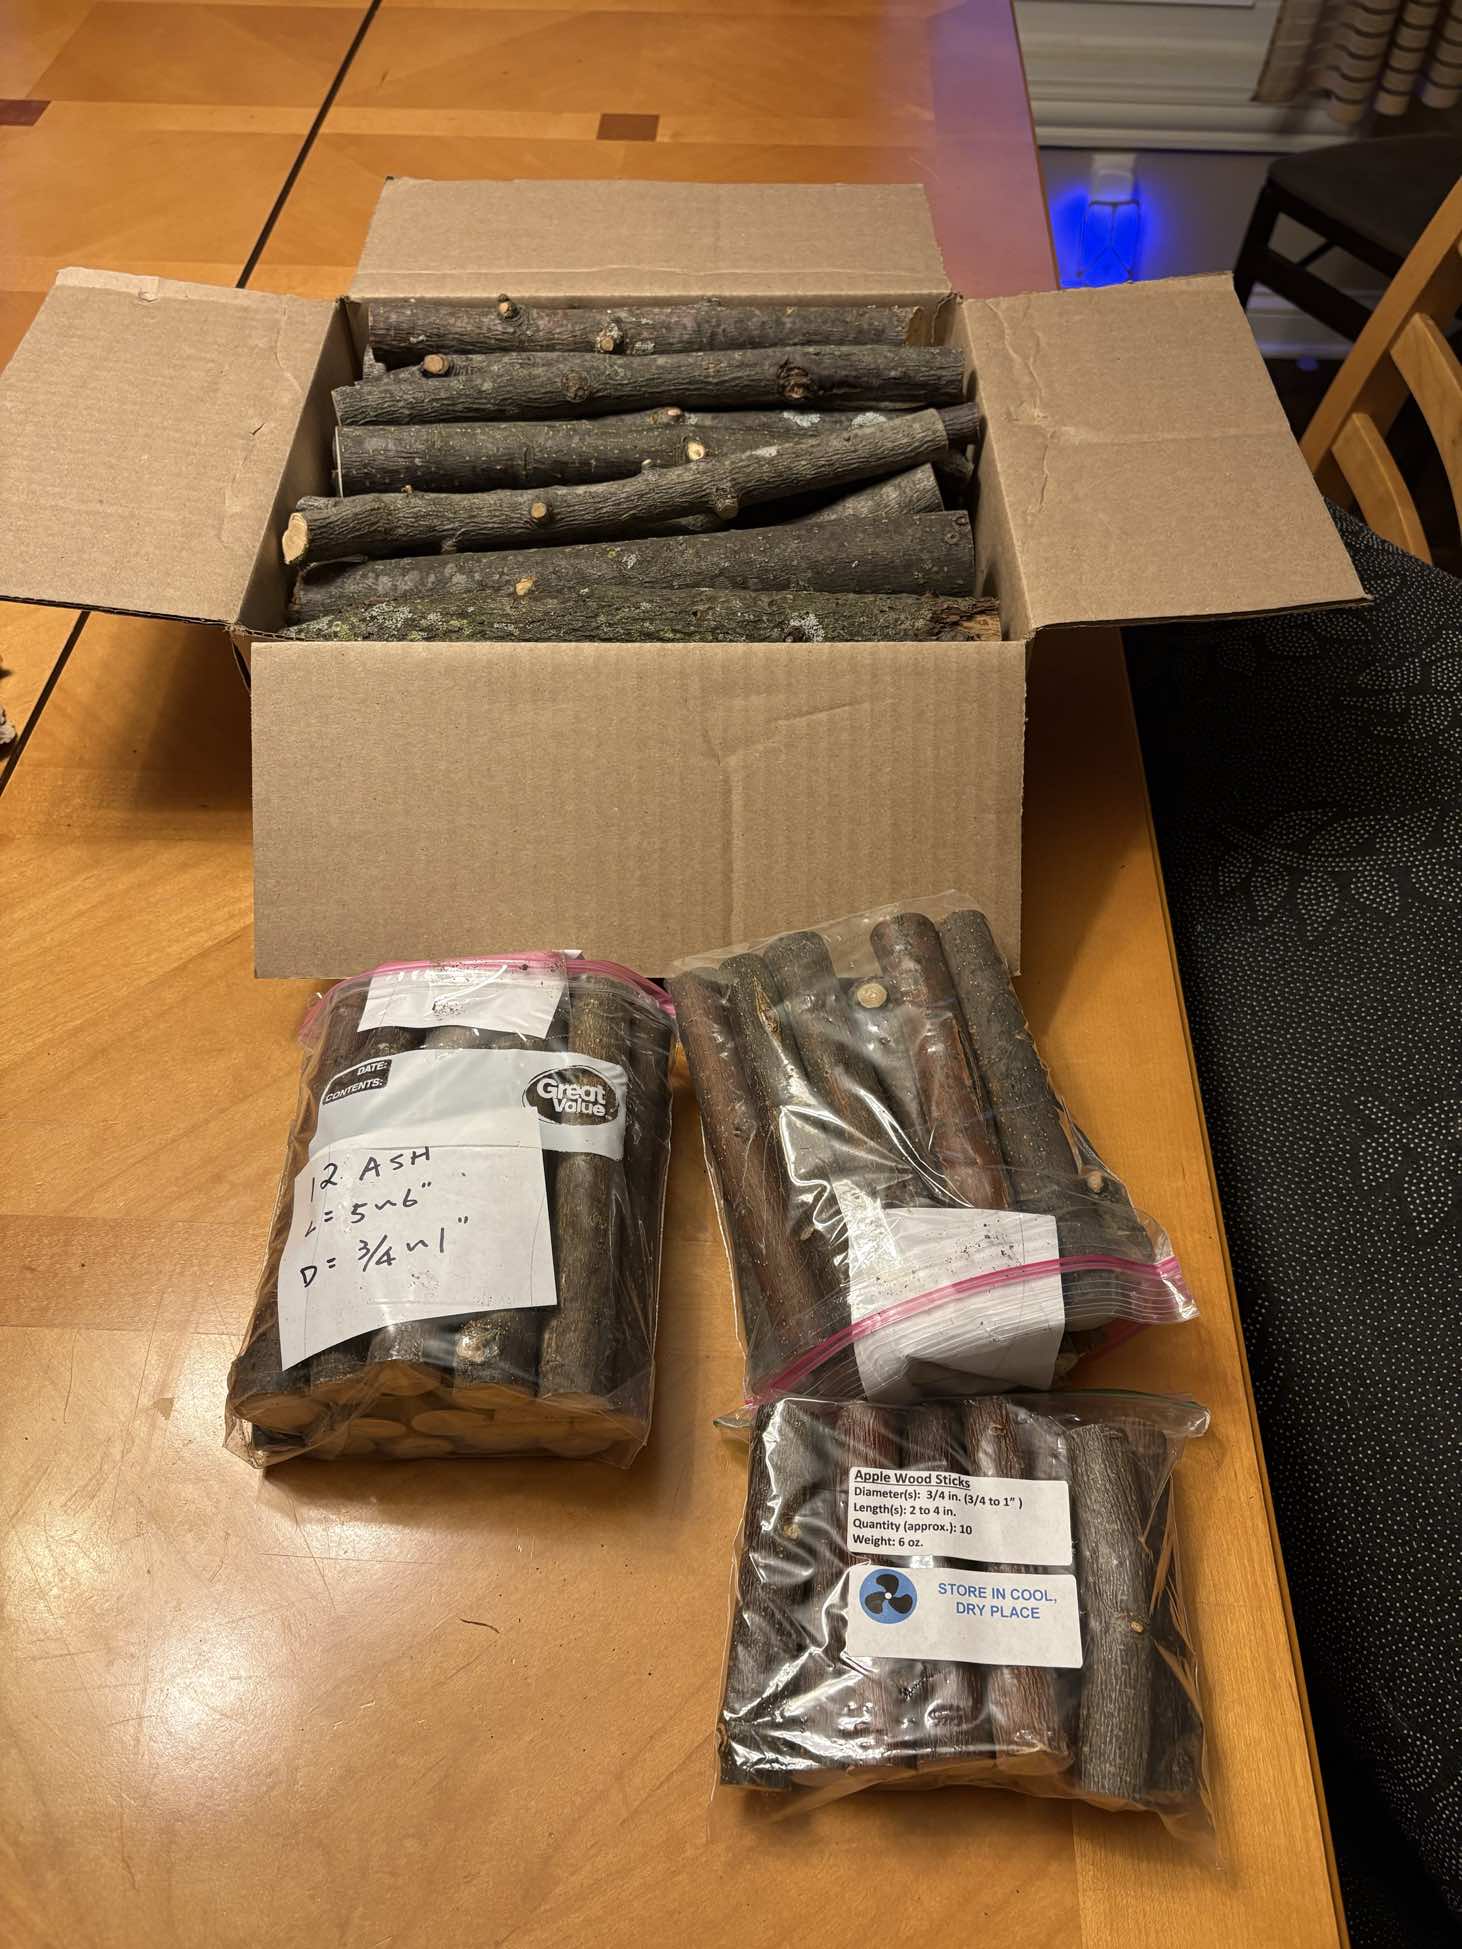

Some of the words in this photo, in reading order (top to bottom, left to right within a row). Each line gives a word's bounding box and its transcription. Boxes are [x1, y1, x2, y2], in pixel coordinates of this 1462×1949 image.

[357, 1061, 388, 1075] DATE:
[325, 1078, 383, 1102] CONTENTS:
[536, 1080, 606, 1105] Great
[553, 1097, 606, 1117] Value
[310, 1162, 338, 1202] 12
[359, 1146, 431, 1181] ASH
[854, 1470, 891, 1483] Apple
[894, 1473, 932, 1484] Wood
[935, 1475, 971, 1488] Sticks
[854, 1487, 921, 1500] Diameter(s):
[926, 1490, 945, 1501] 3/4
[948, 1492, 961, 1502] in.
[964, 1494, 986, 1506] (3/4
[989, 1497, 1000, 1506] to
[854, 1503, 907, 1517] Length(s):
[909, 1505, 916, 1515] 2
[919, 1506, 931, 1515] to
[933, 1506, 940, 1515] 4
[943, 1507, 956, 1516] in.
[853, 1519, 901, 1532] Quantity
[904, 1521, 957, 1534] (approx.):
[959, 1524, 972, 1534] 10
[853, 1535, 895, 1547] Weight:
[898, 1537, 905, 1546] 6
[908, 1539, 924, 1547] oz.
[938, 1583, 987, 1598] STORE
[992, 1587, 1006, 1599] IN
[1010, 1588, 1057, 1604] COOL,
[956, 1602, 985, 1616] DRY
[990, 1605, 1040, 1619] PLACE
